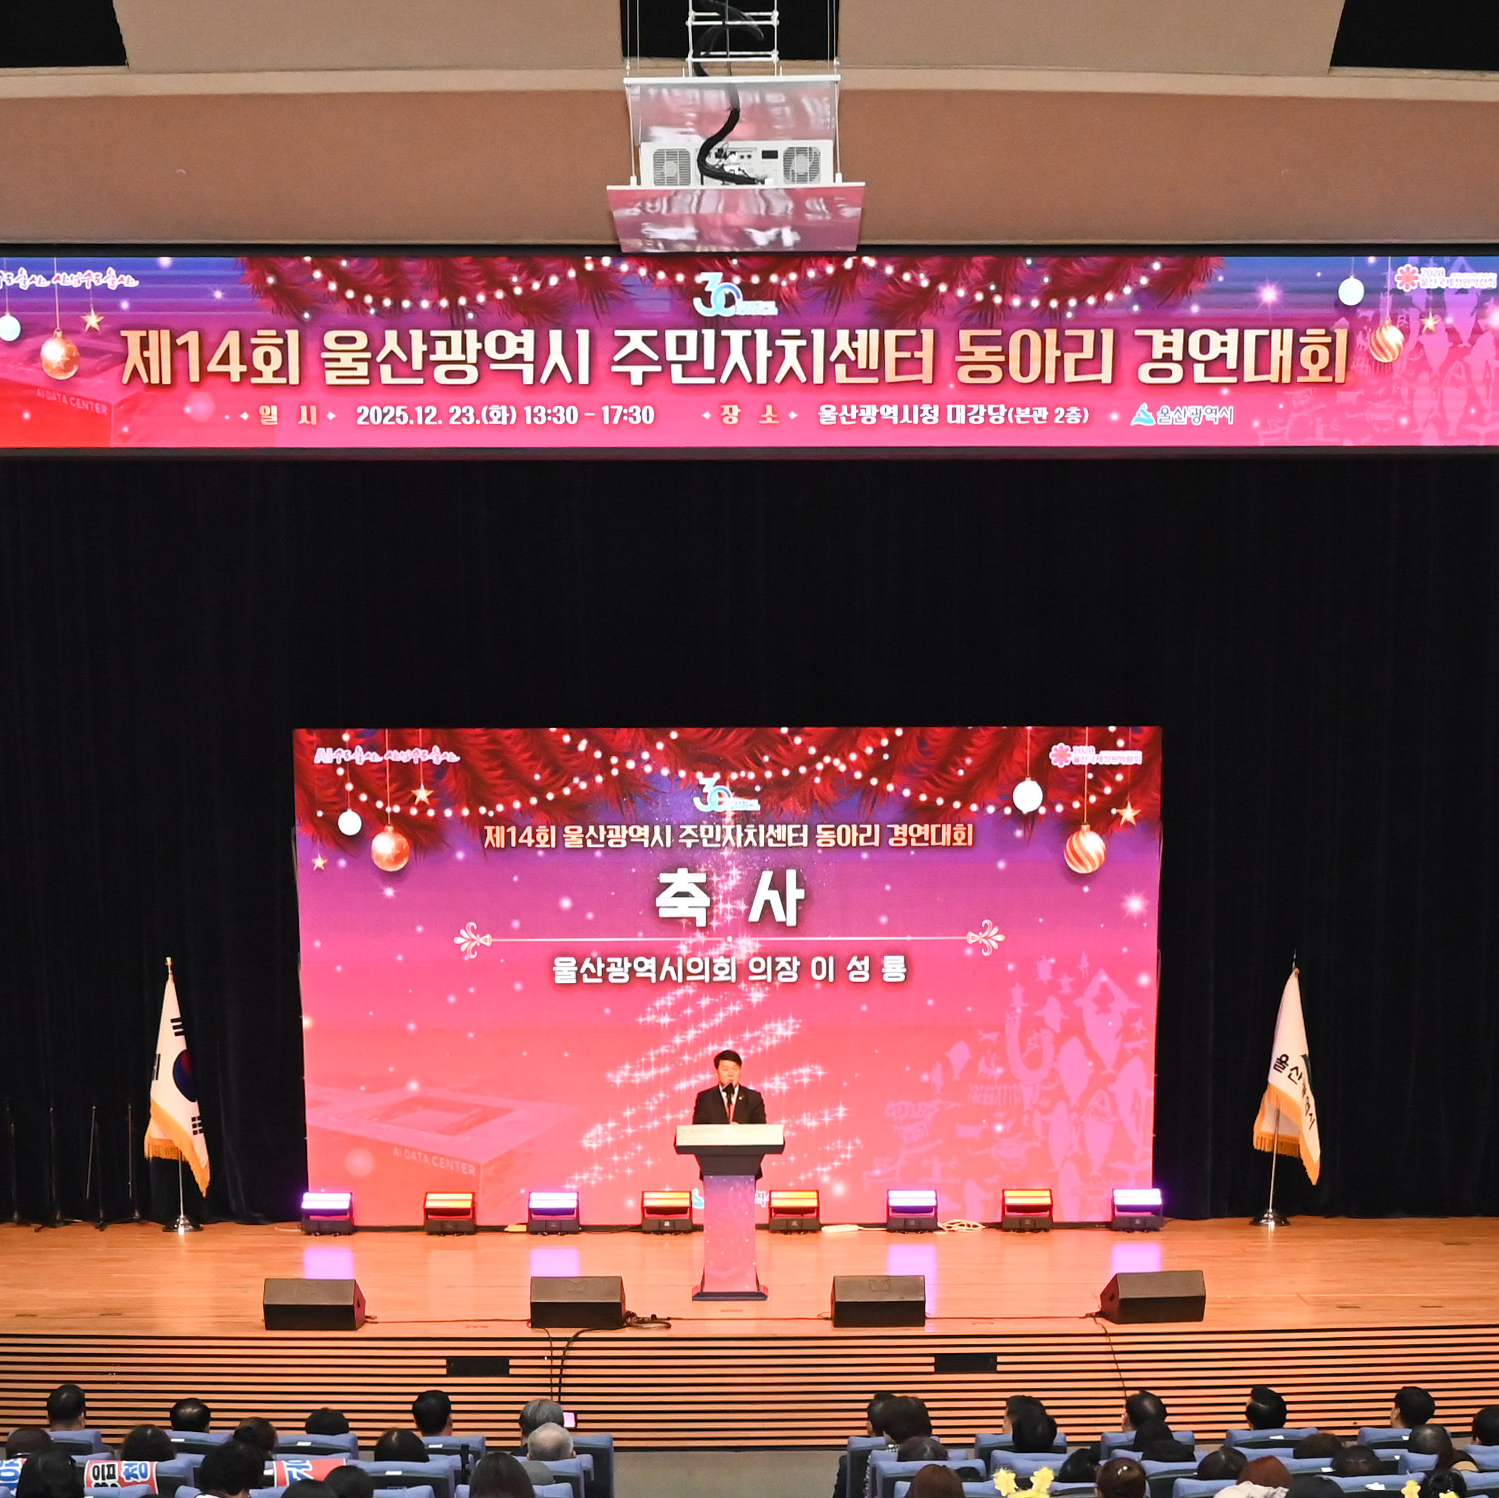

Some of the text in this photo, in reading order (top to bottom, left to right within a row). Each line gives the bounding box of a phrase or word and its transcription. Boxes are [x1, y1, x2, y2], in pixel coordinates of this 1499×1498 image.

[120, 327, 1349, 386] 제14회 울산광역시 주민자치센터 동아리 경연대회
[69, 396, 108, 415] CENTER
[356, 404, 443, 426] 2025.12.
[448, 403, 517, 426] 23.(화)
[523, 404, 579, 426] 13:30
[601, 404, 655, 426] 17:30
[817, 403, 940, 426] 울산광역시청
[1156, 405, 1235, 426] 울산광역시
[483, 823, 974, 848] 제14회 울산광역시 주민자치센터 동아리 경연대회
[655, 867, 806, 928] 축 사
[552, 956, 737, 984] 울산광역시의회
[748, 955, 801, 984] 의장
